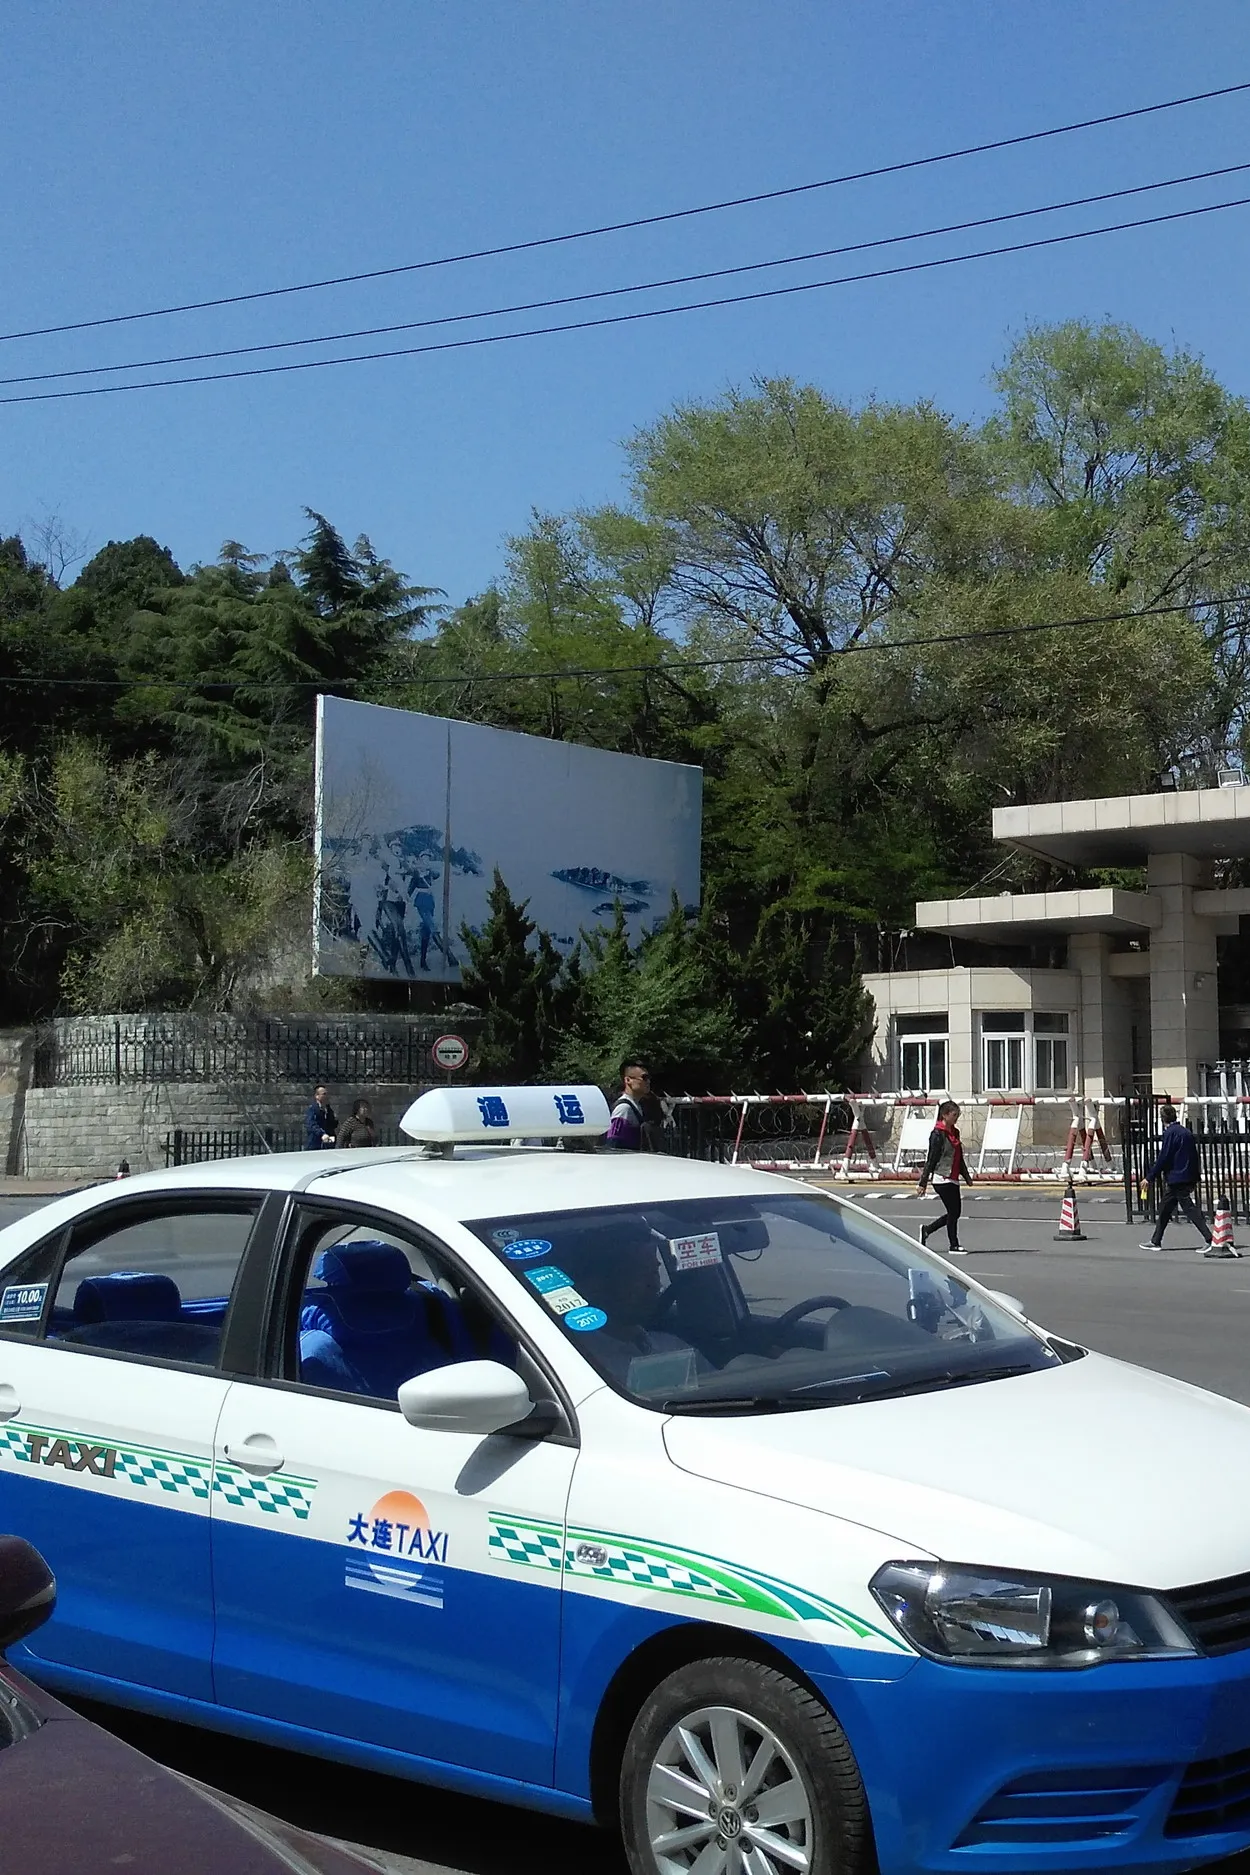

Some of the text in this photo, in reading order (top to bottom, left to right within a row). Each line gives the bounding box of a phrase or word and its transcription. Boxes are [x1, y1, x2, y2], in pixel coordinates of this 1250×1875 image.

[677, 1236, 717, 1260] 空车
[681, 1261, 699, 1269] FOR
[555, 1299, 583, 1313] 2017
[576, 1314, 599, 1328] 2017
[27, 1433, 117, 1479] TAXI
